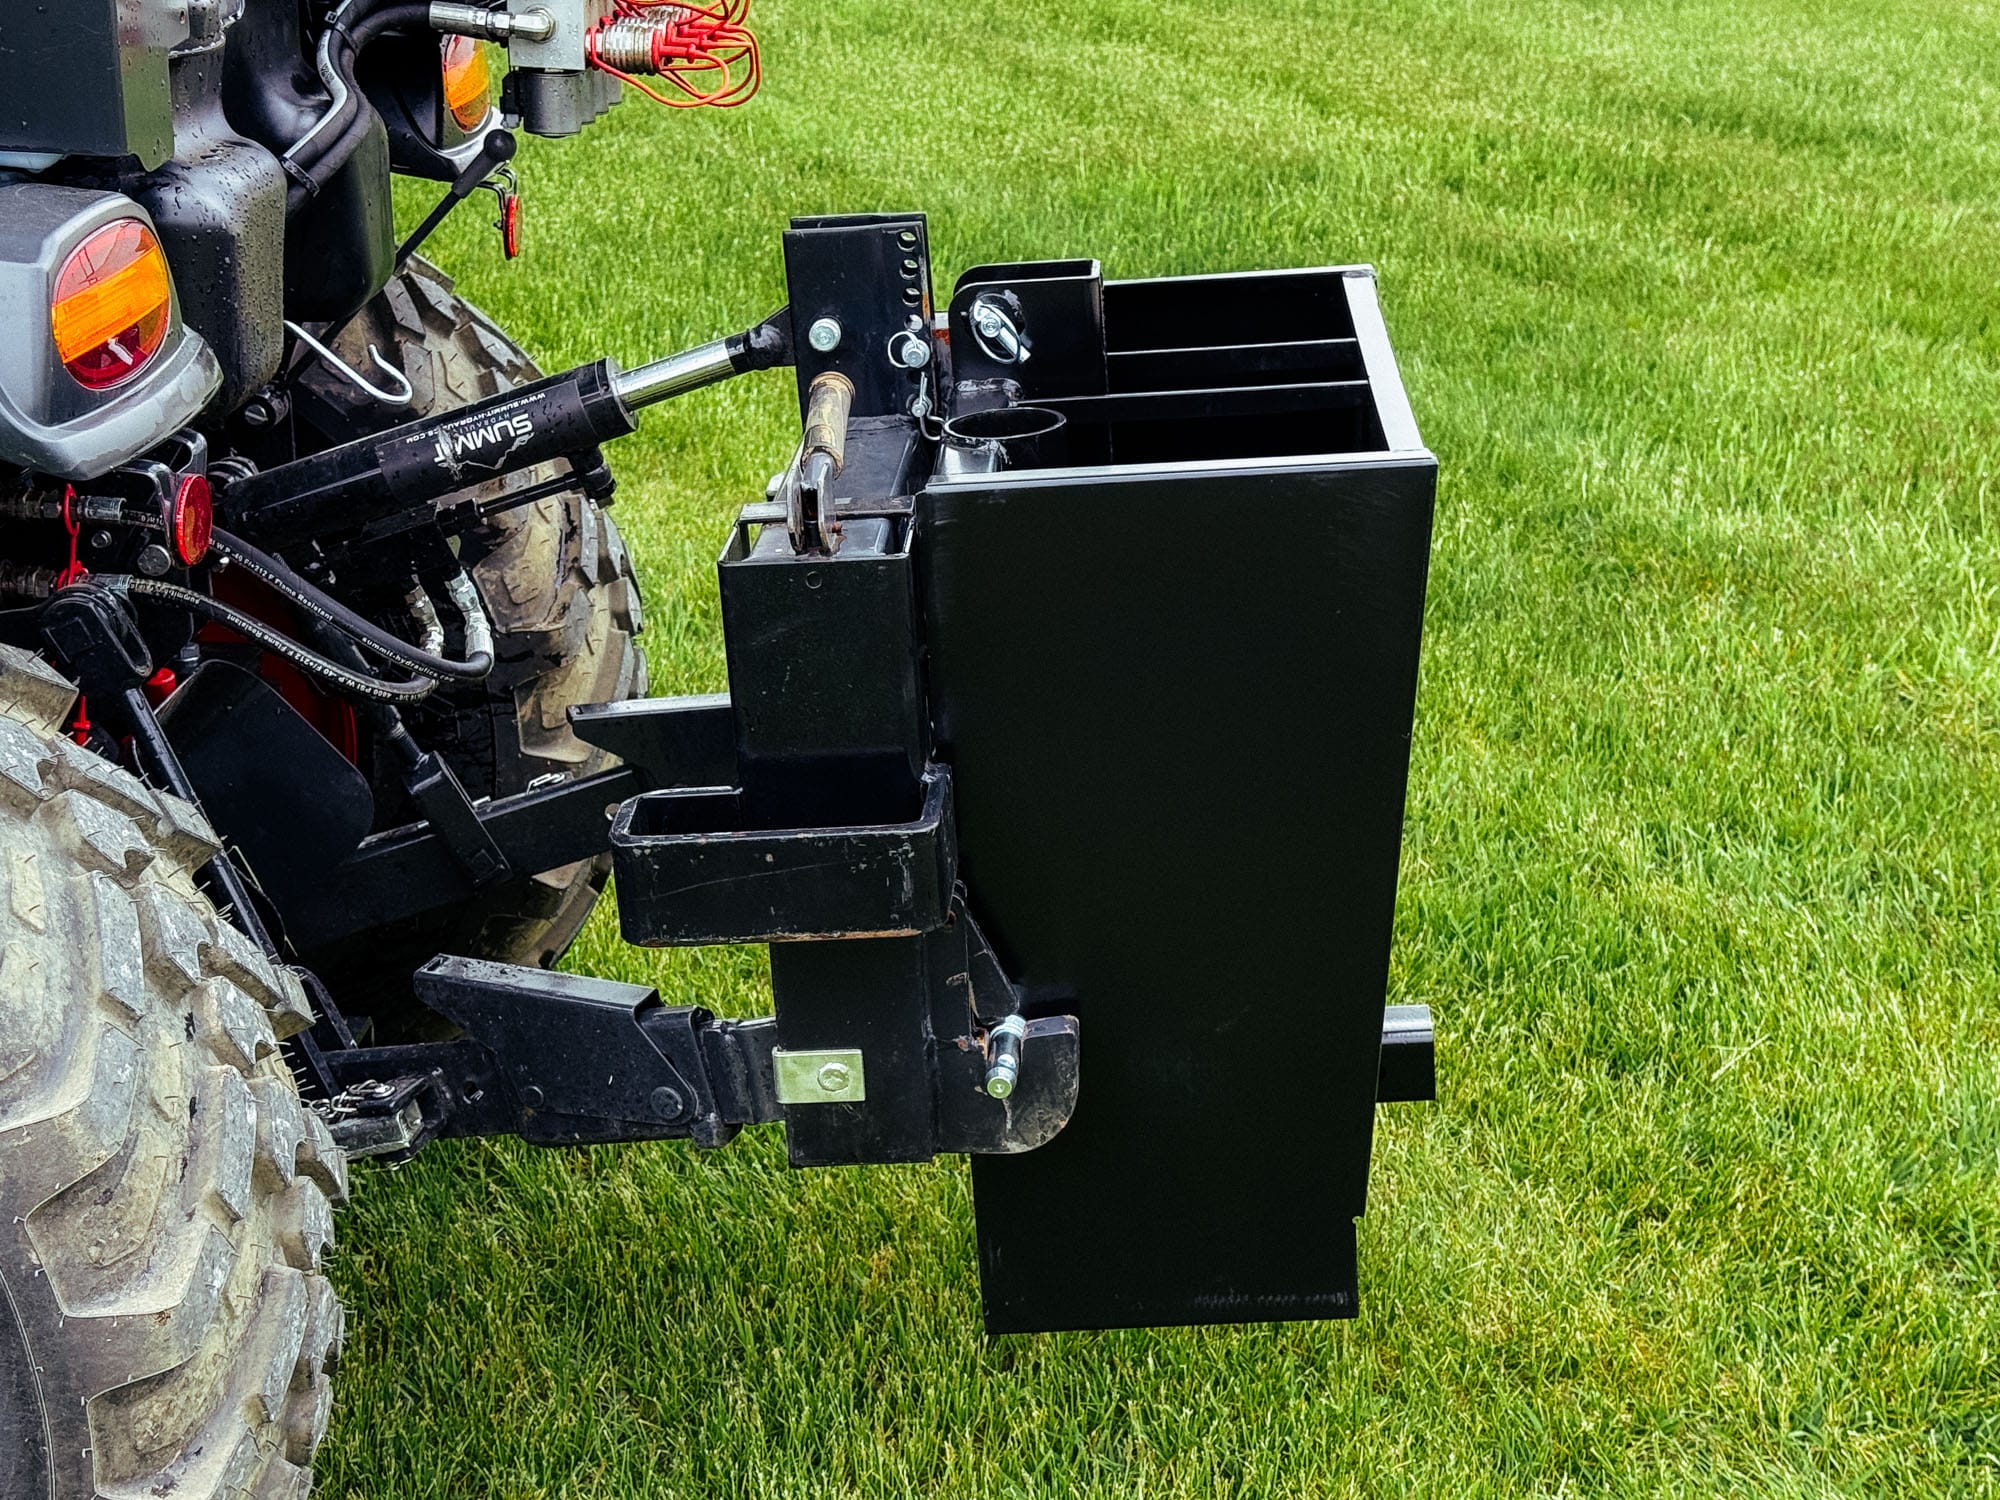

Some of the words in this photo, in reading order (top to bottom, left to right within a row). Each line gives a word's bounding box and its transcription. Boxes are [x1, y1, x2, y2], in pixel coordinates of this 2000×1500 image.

[274, 578, 297, 597] Flame
[297, 593, 334, 621] Resistant
[226, 613, 262, 638] Resistant
[263, 634, 287, 652] Flame
